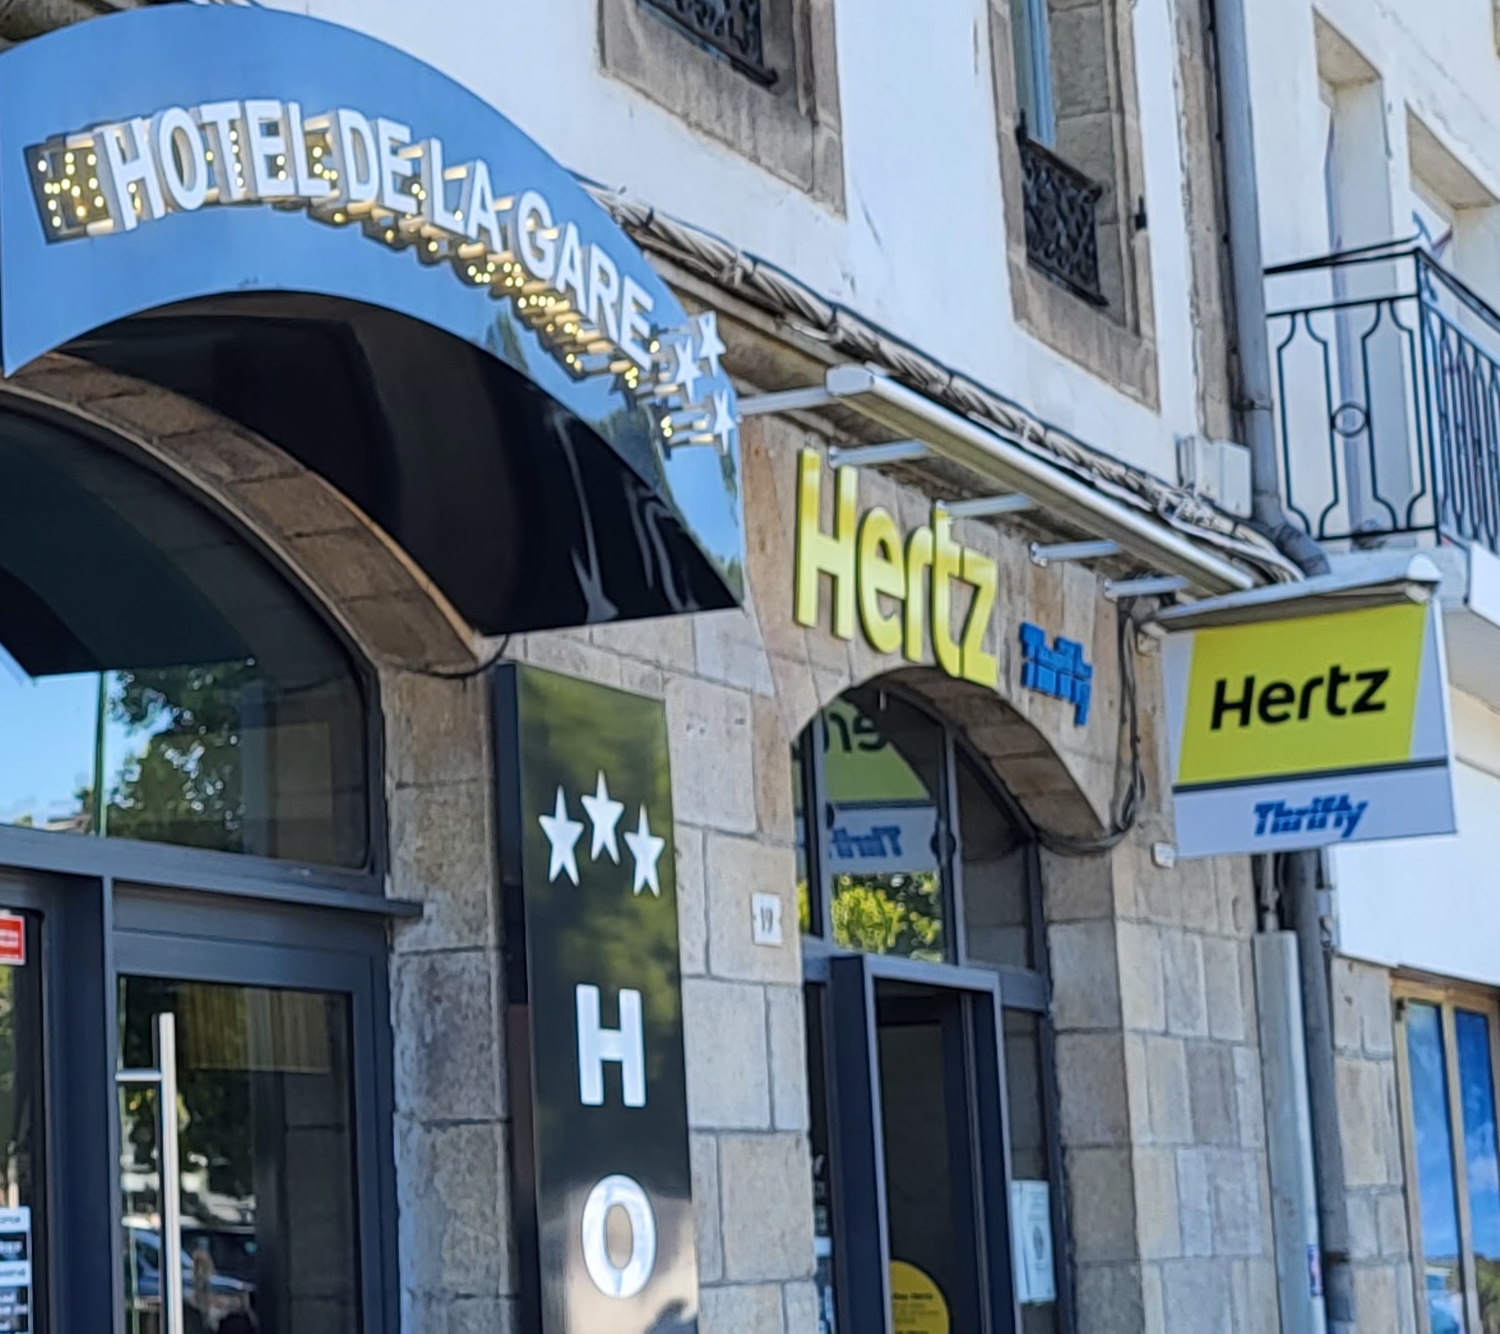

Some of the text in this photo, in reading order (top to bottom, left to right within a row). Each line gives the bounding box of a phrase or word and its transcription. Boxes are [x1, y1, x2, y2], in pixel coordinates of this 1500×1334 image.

[96, 99, 656, 370] HOTEL DE LA GARE
[793, 447, 998, 687] Hertz
[1209, 664, 1391, 732] Hertz
[1253, 794, 1369, 839] Thrifty
[760, 906, 774, 934] 19
